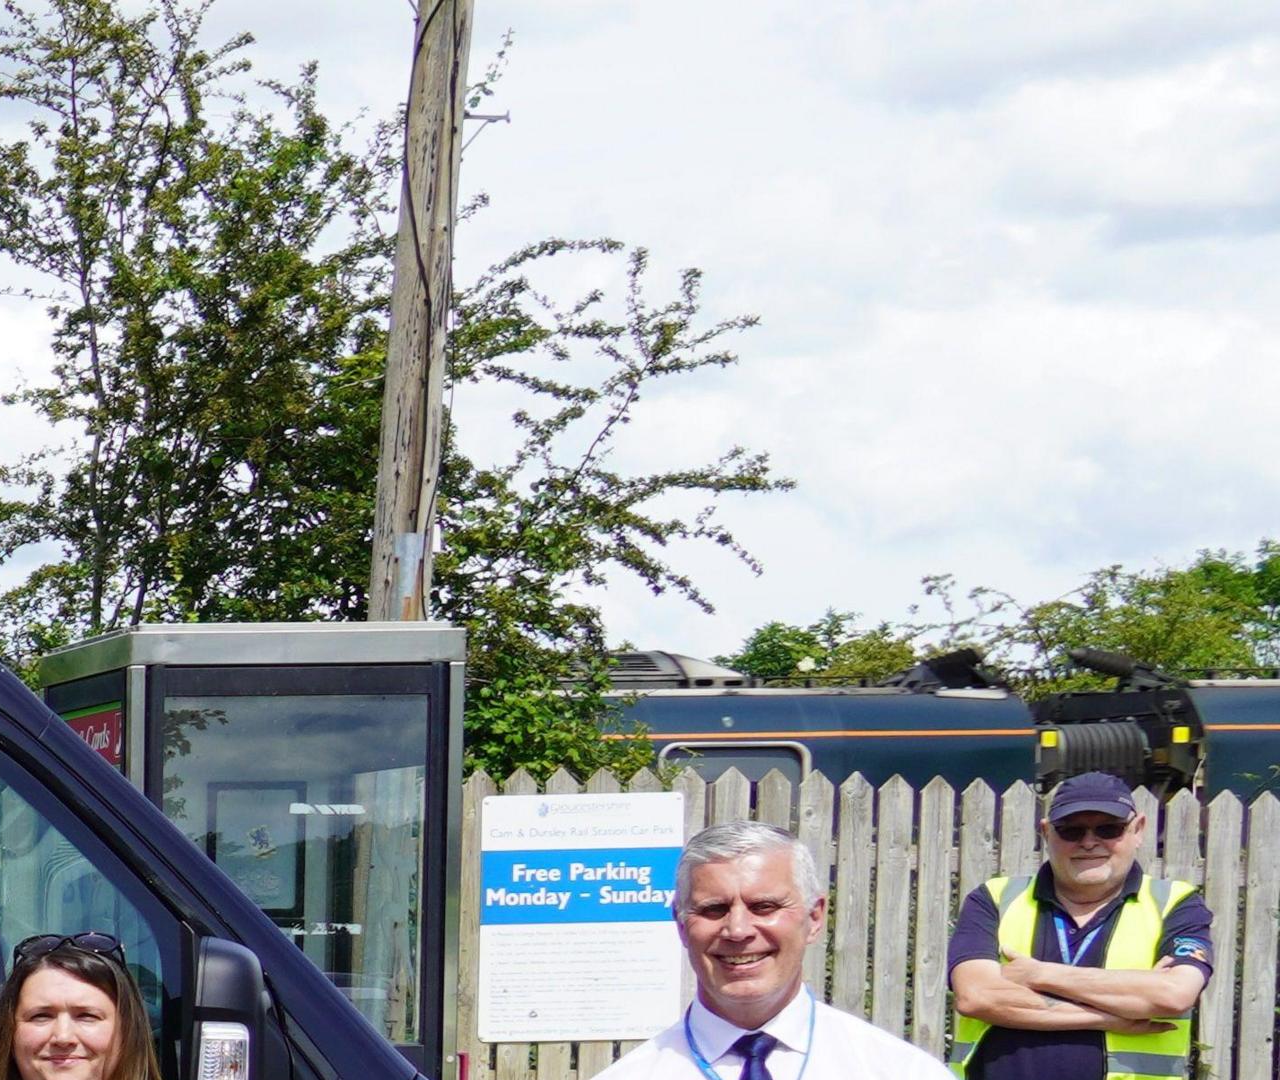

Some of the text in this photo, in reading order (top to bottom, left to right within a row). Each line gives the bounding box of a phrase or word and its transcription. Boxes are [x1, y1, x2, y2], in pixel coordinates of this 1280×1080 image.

[592, 826, 627, 837] Station
[652, 825, 674, 835] Park
[512, 862, 652, 885] Free Parking
[486, 887, 571, 910] Monday
[599, 885, 676, 908] Sunday
